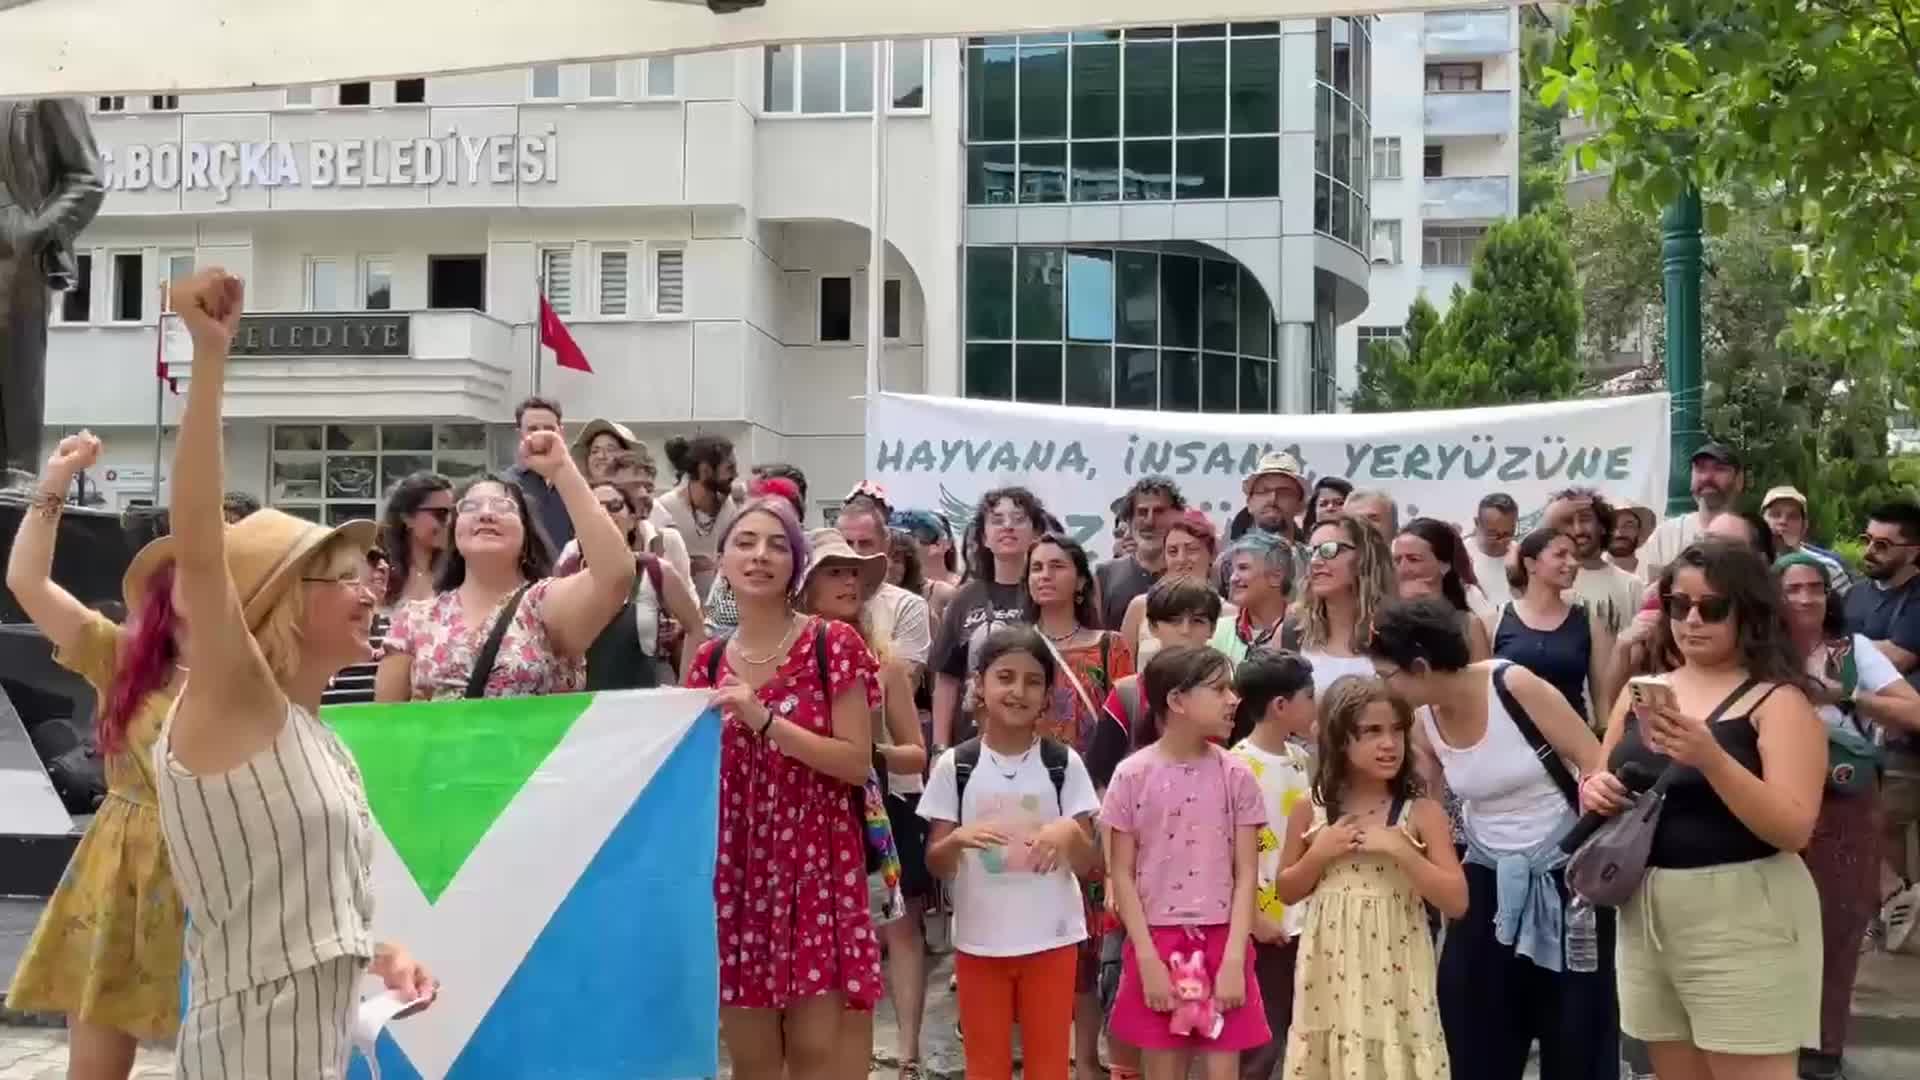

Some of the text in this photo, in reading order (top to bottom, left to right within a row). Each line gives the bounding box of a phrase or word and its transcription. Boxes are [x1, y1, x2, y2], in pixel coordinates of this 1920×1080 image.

[311, 122, 558, 188] BELEDİYESİ
[876, 439, 1097, 480] HAYVANA,
[1344, 434, 1633, 481] YERYÜZÜNE
